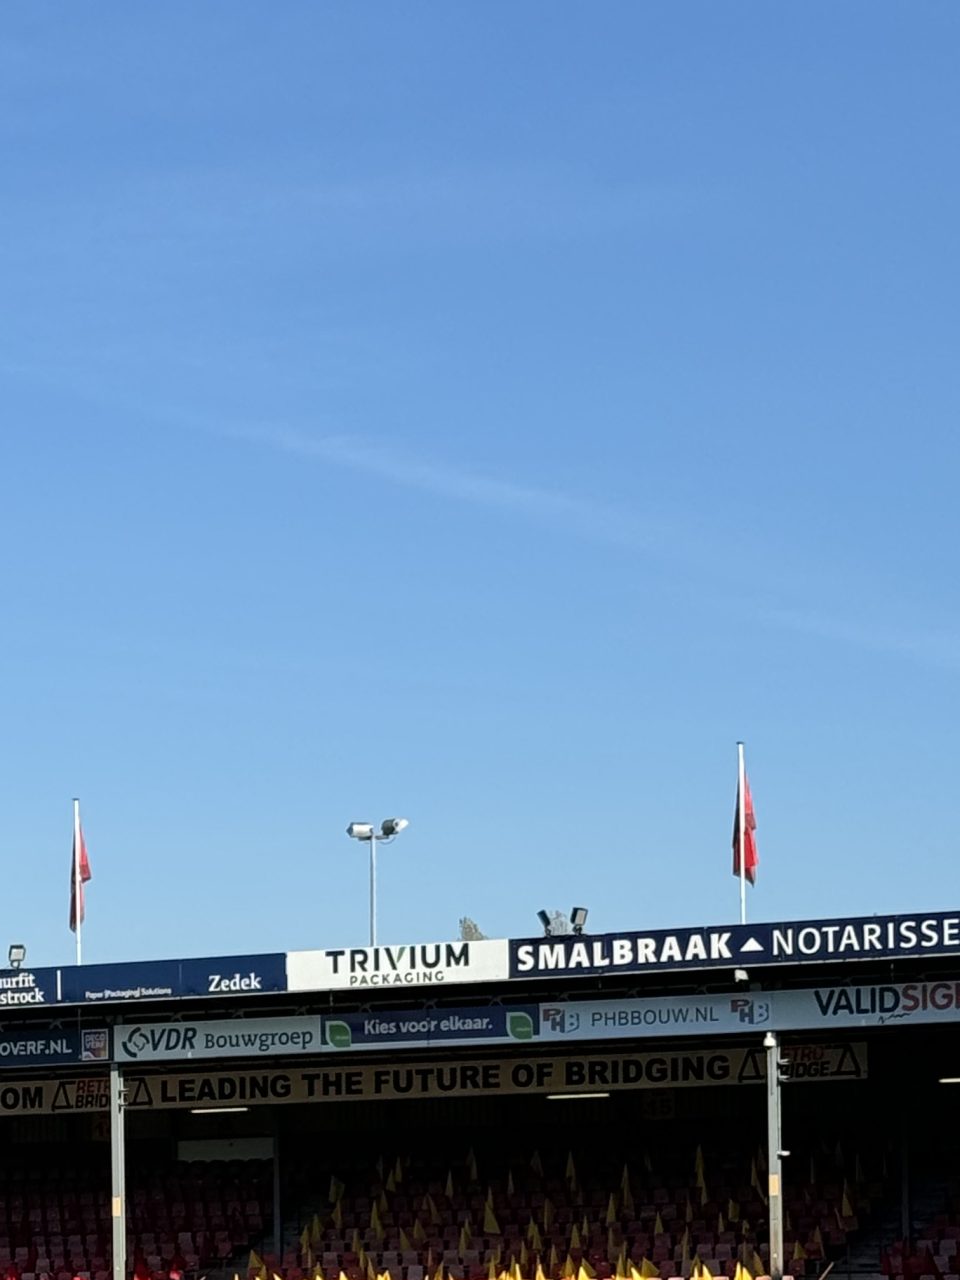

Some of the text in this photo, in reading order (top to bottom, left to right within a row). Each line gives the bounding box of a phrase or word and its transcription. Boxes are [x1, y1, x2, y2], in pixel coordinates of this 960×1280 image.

[517, 918, 960, 971] SMALBRAAK NOTARISSE
[325, 943, 470, 974] TRIVIUM
[208, 972, 262, 992] Zedek
[349, 971, 445, 986] PACKAGING
[813, 983, 960, 1017] VALIDSIG
[364, 1015, 493, 1036] Kies voor elkaar.
[591, 1006, 719, 1027] PHBBOUW.NL
[150, 1026, 314, 1052] VDR Bouwgroep
[160, 1054, 730, 1102] LEADING THE FUTURE OF BRIDGING
[75, 1094, 111, 1109] BRID
